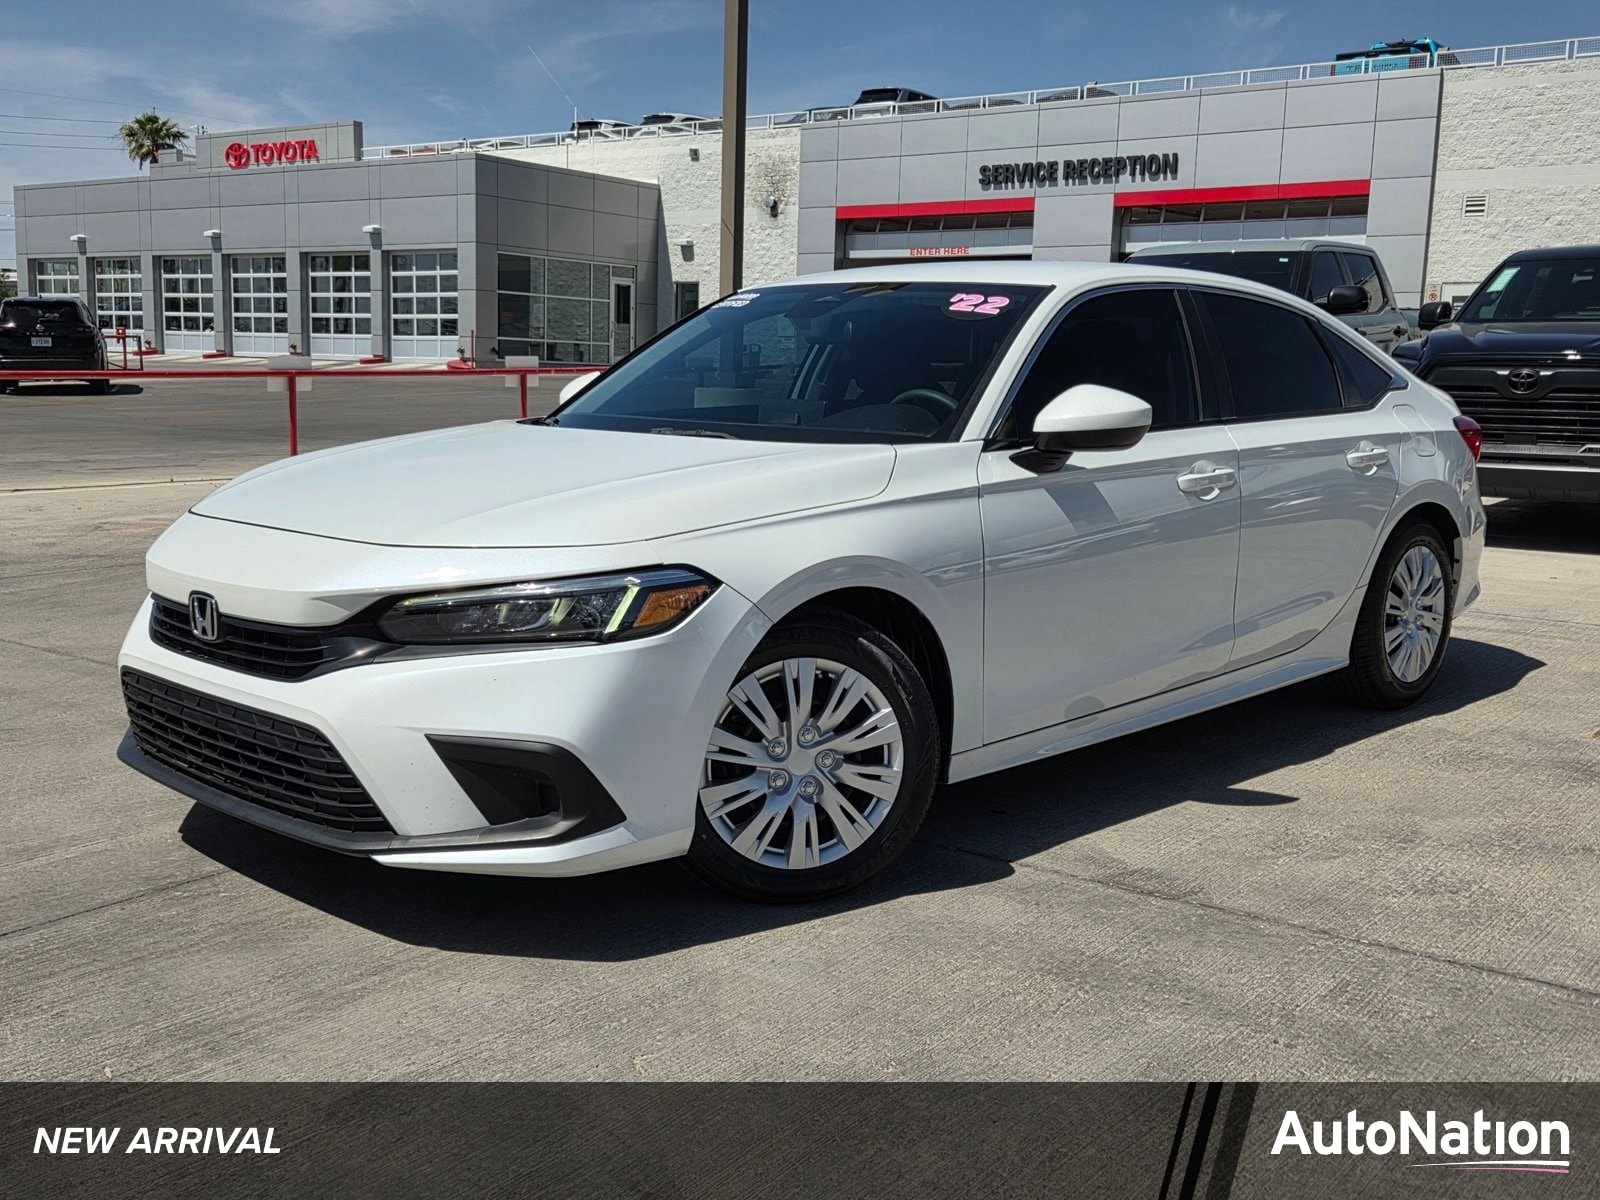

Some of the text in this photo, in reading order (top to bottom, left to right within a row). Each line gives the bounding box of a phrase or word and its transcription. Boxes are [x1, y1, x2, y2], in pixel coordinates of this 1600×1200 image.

[251, 139, 318, 164] TOYOTA
[979, 152, 1179, 189] SERVICE RECEPTION
[910, 246, 970, 257] ENTER HERE
[949, 293, 1010, 315] '22
